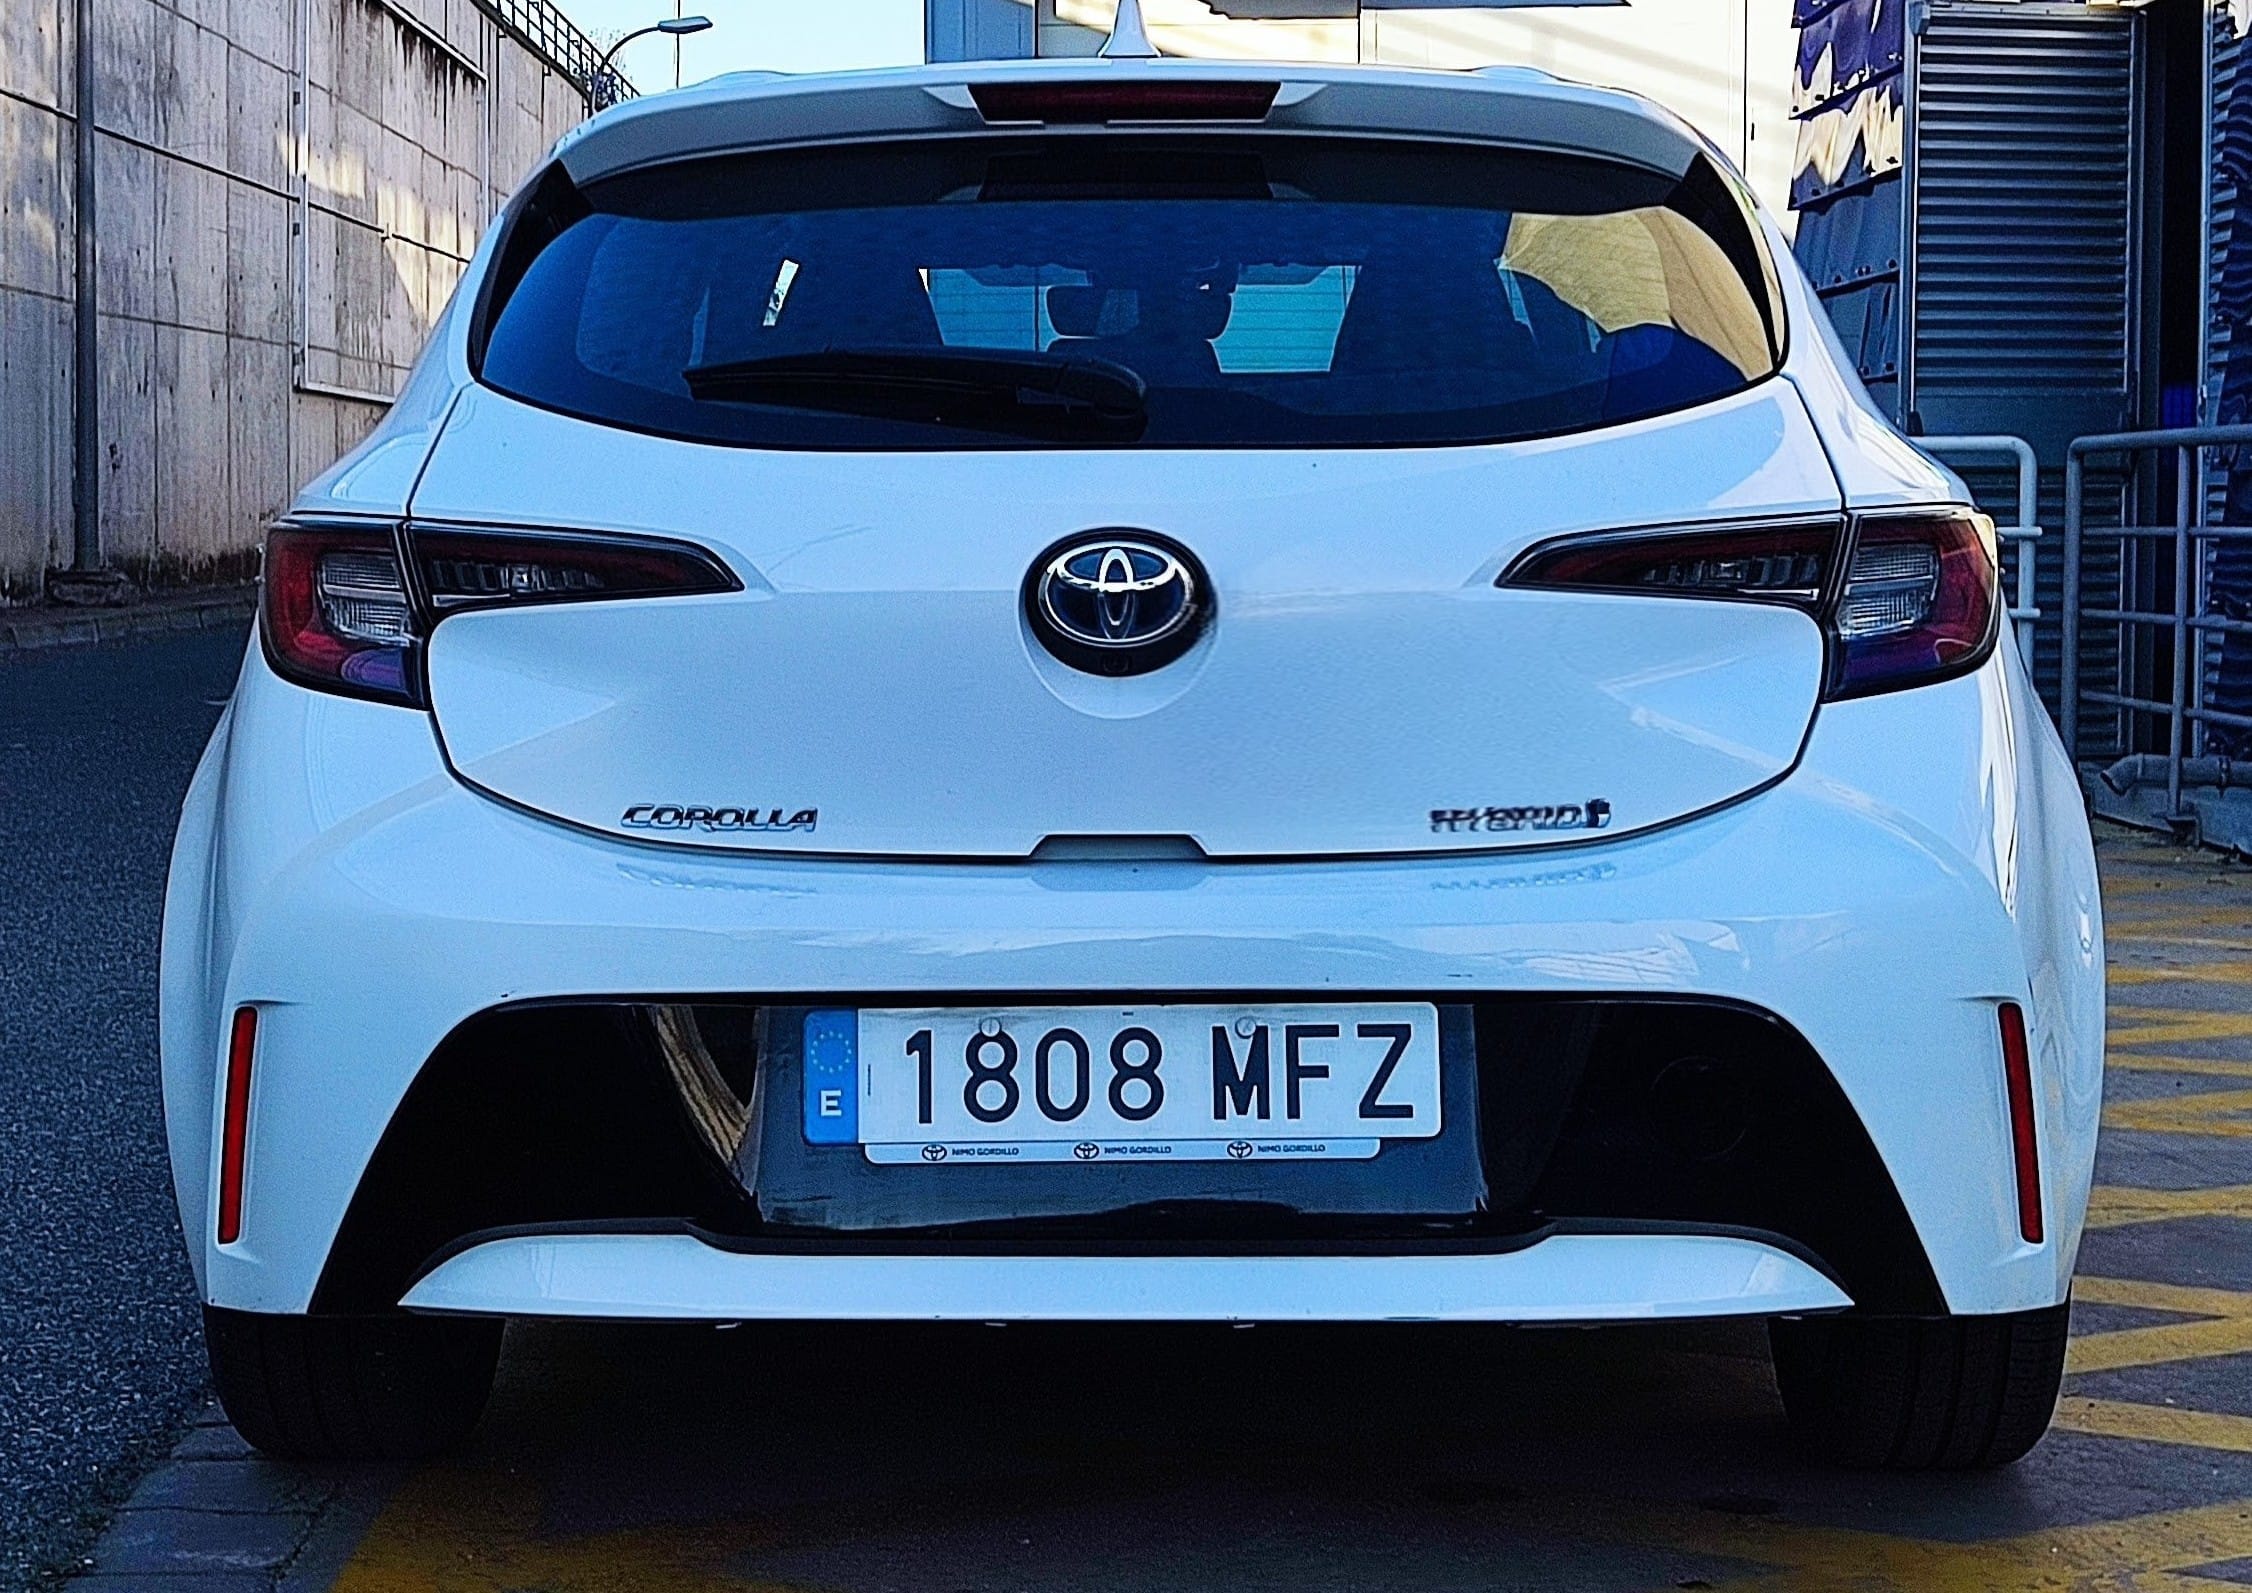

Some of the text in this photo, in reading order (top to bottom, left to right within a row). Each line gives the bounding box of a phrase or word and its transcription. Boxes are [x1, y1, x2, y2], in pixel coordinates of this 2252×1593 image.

[620, 803, 818, 833] COROLLA
[1430, 803, 1584, 833] HYBRID
[906, 1023, 1414, 1124] 1808 MFZ
[820, 1090, 842, 1116] E
[951, 1147, 1020, 1156] NIMO GORDILLO
[1104, 1145, 1172, 1155] NIMO GORDILLO
[1257, 1144, 1326, 1153] NIMO GORDILLO
